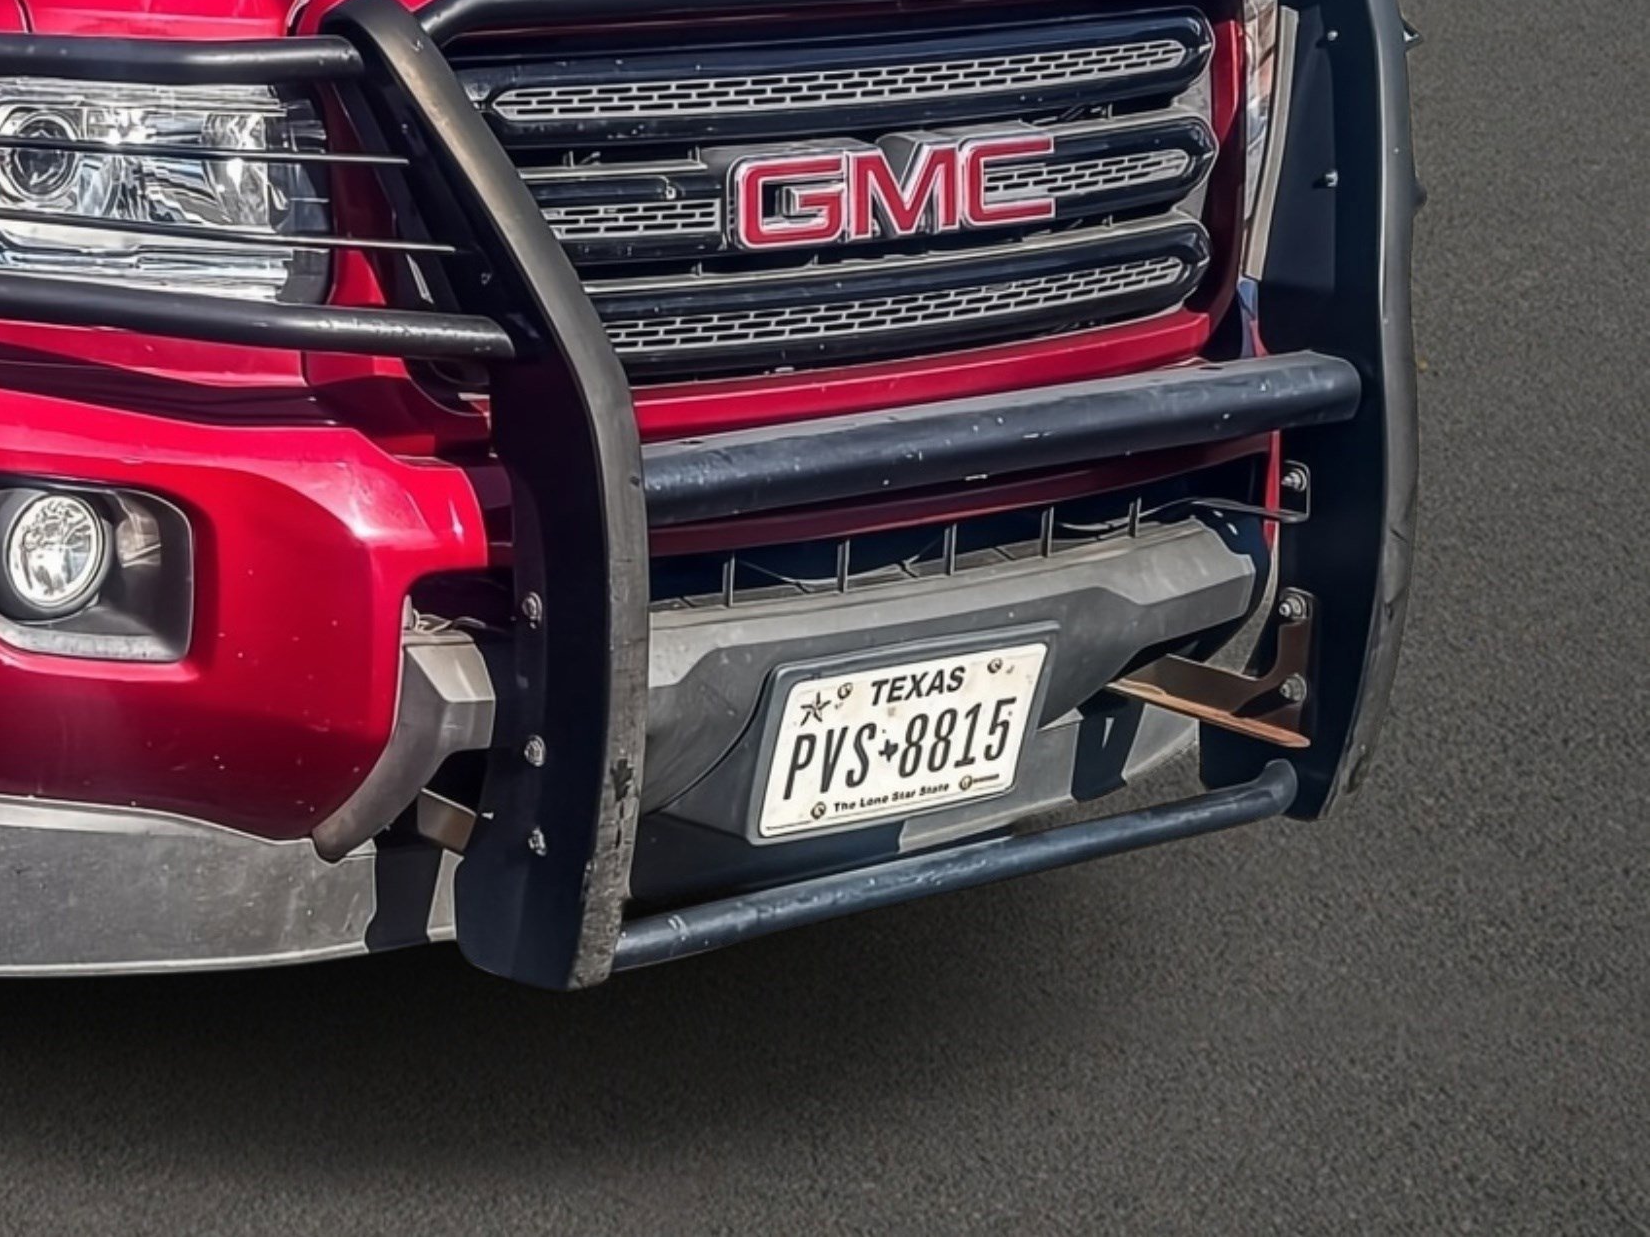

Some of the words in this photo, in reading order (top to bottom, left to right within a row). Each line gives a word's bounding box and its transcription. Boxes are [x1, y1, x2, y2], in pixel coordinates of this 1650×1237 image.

[735, 134, 1056, 248] GMC
[870, 665, 967, 706] TEXAS
[897, 696, 1018, 779] 8815
[833, 800, 856, 812] The
[859, 794, 890, 808] Lone
[891, 789, 917, 802] Star
[918, 782, 950, 797] State
